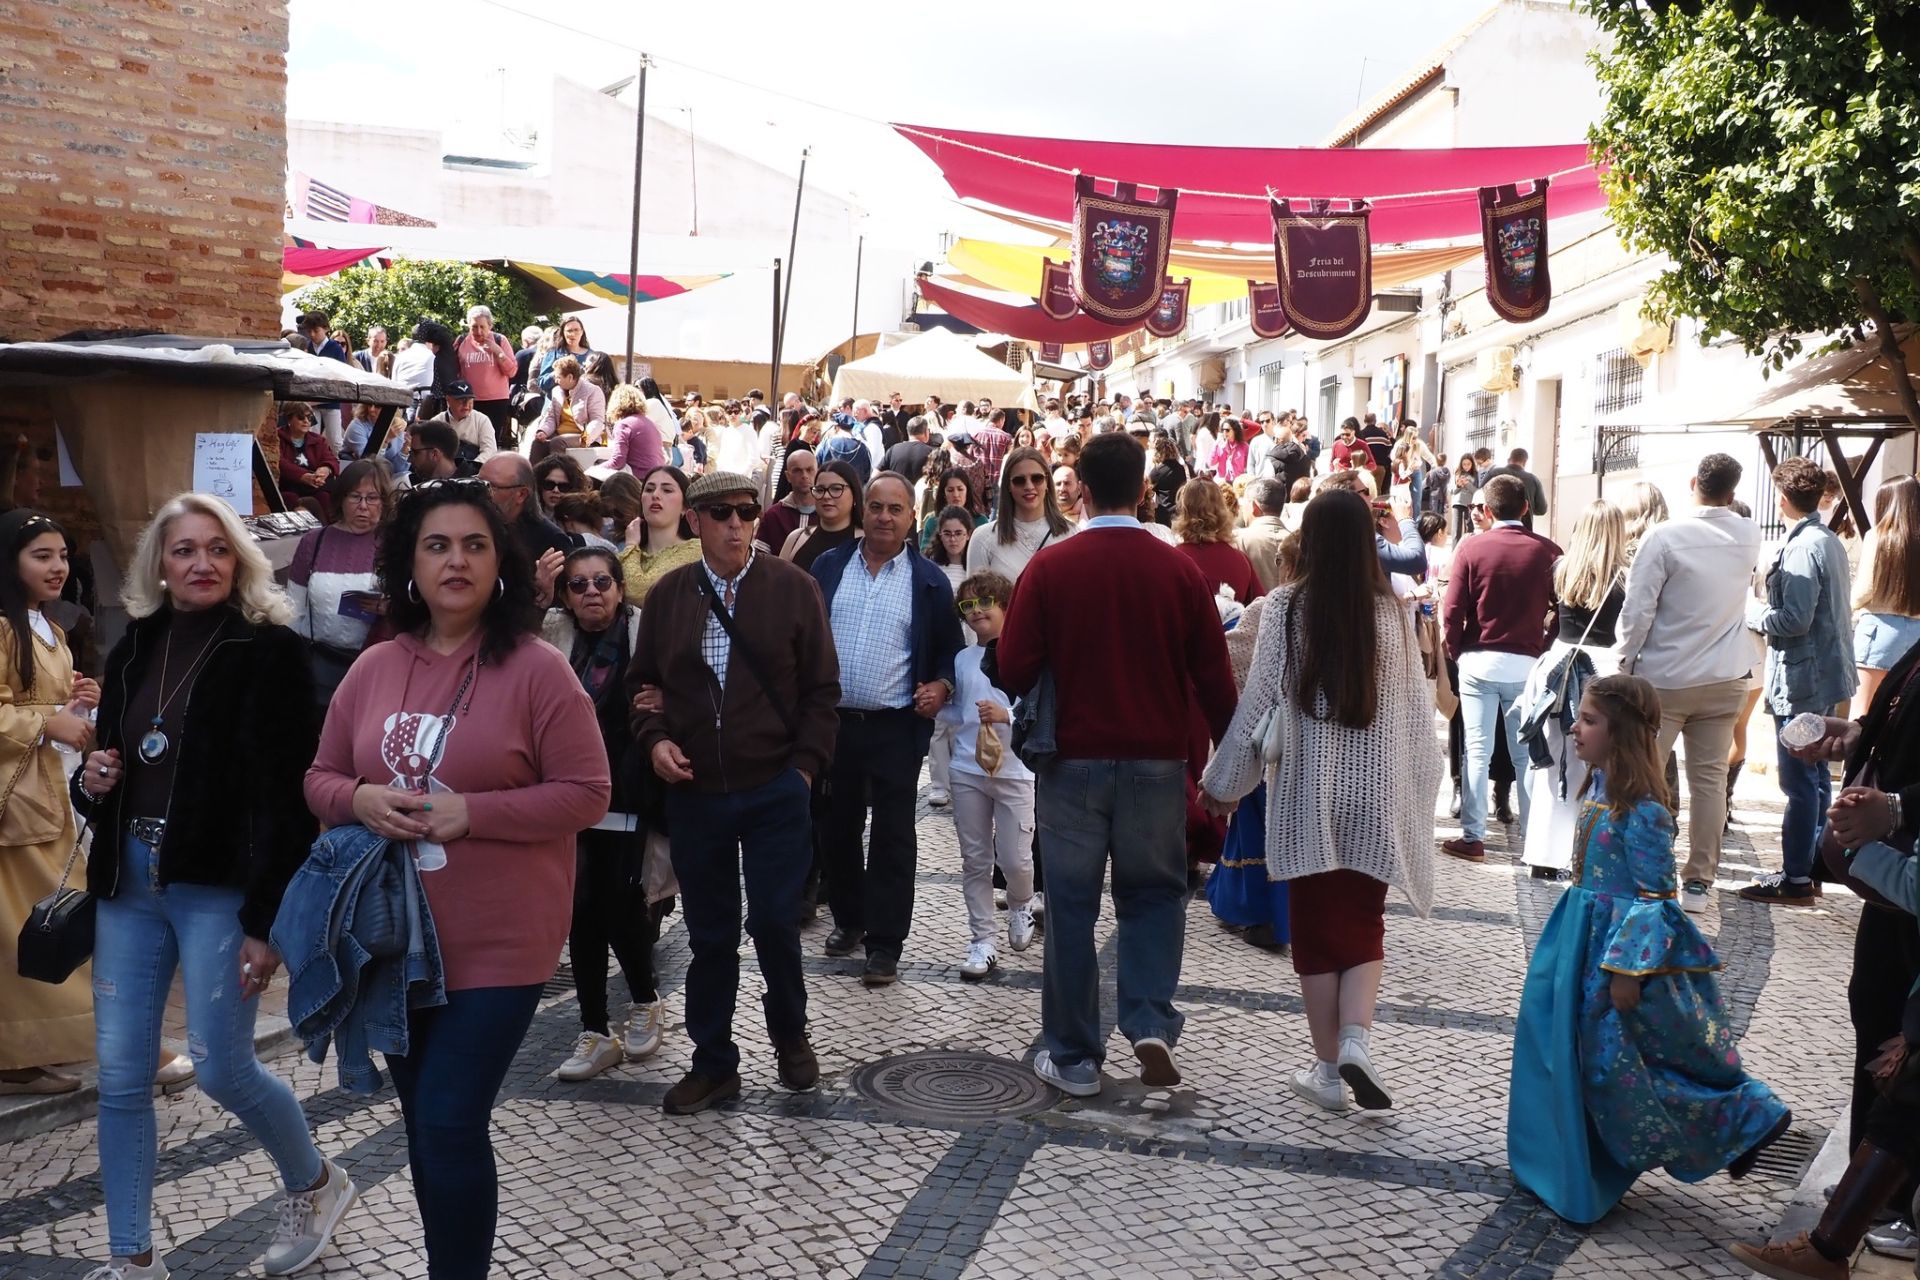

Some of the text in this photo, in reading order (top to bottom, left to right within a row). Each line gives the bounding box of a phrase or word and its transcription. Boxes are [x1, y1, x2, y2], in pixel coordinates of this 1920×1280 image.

[1309, 257, 1344, 268] Feria del
[1296, 269, 1356, 278] Descubrimiento
[208, 438, 225, 453] Hay
